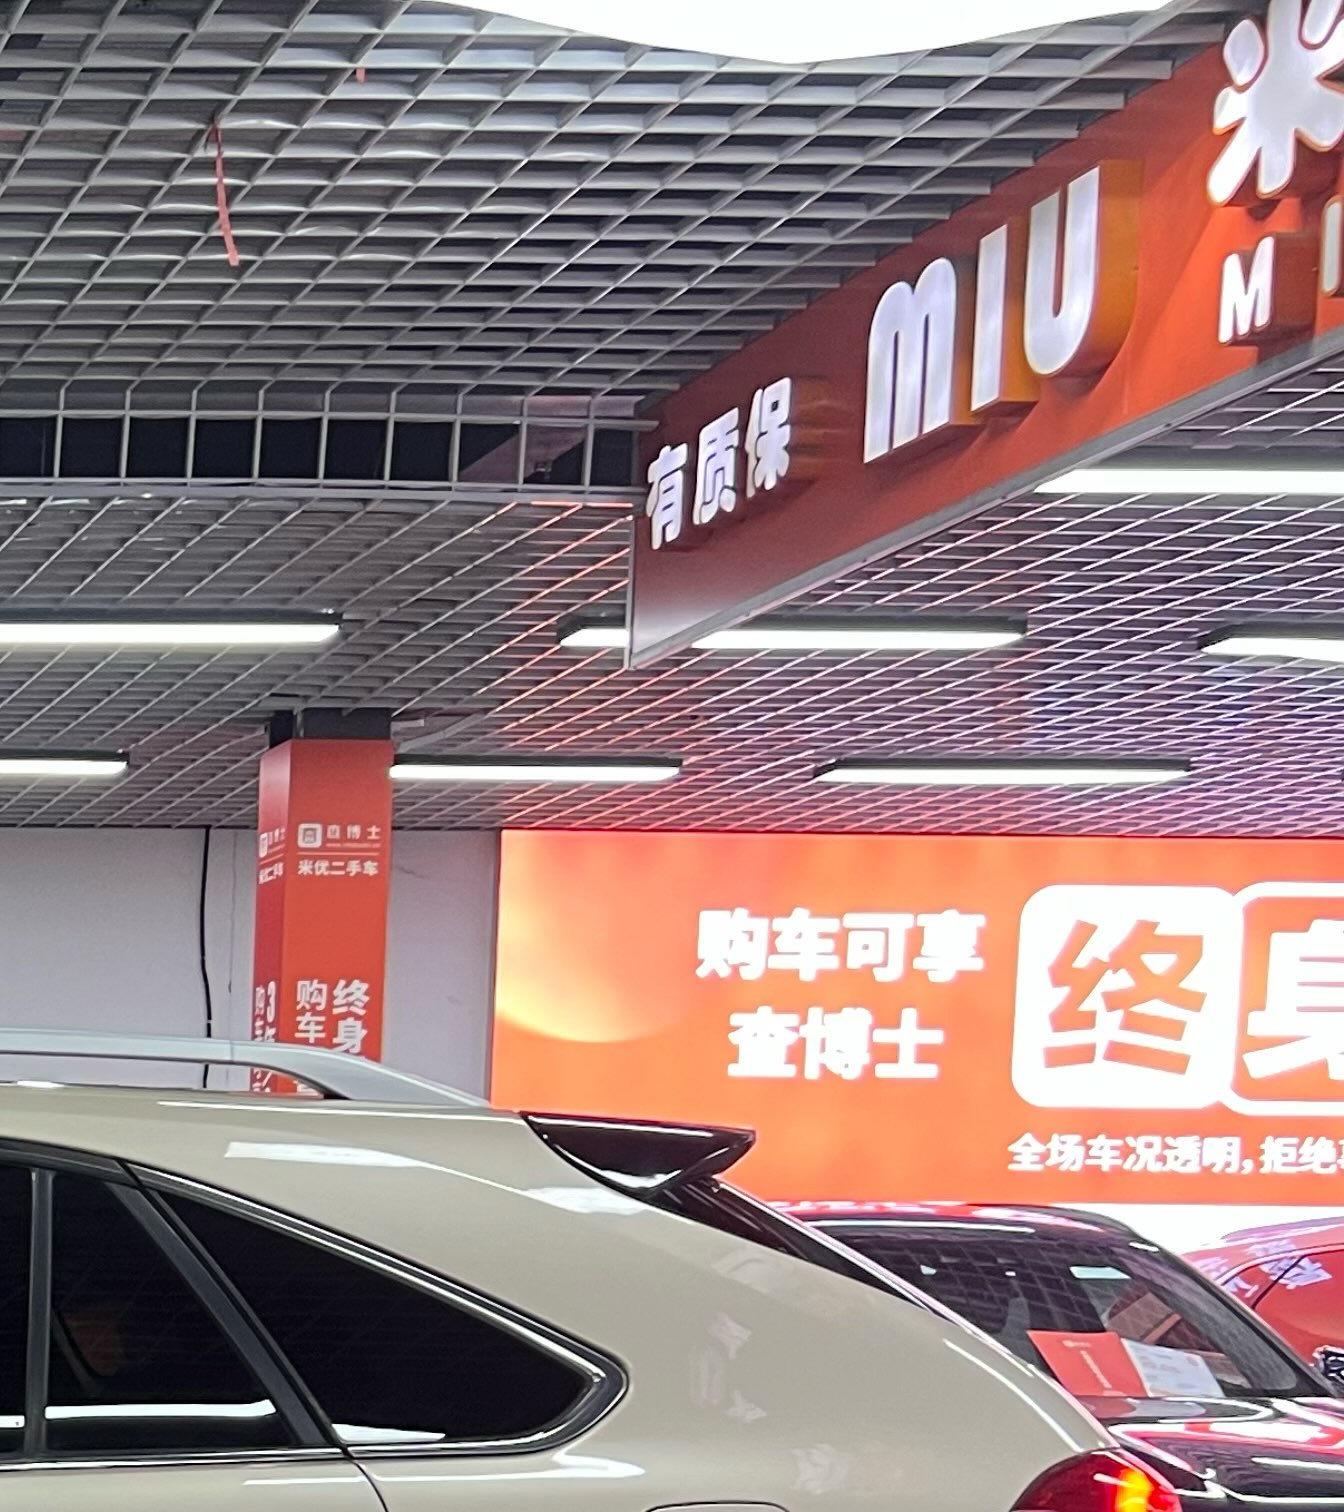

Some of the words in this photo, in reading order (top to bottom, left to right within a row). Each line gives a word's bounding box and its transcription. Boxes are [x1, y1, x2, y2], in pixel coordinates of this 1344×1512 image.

[645, 376, 793, 550] 有质保
[297, 859, 379, 877] 米优二手车
[696, 907, 987, 982] 购车可享
[727, 1005, 945, 1080] 查博士
[1007, 1132, 1344, 1175] 全场车况透明，拒绝
